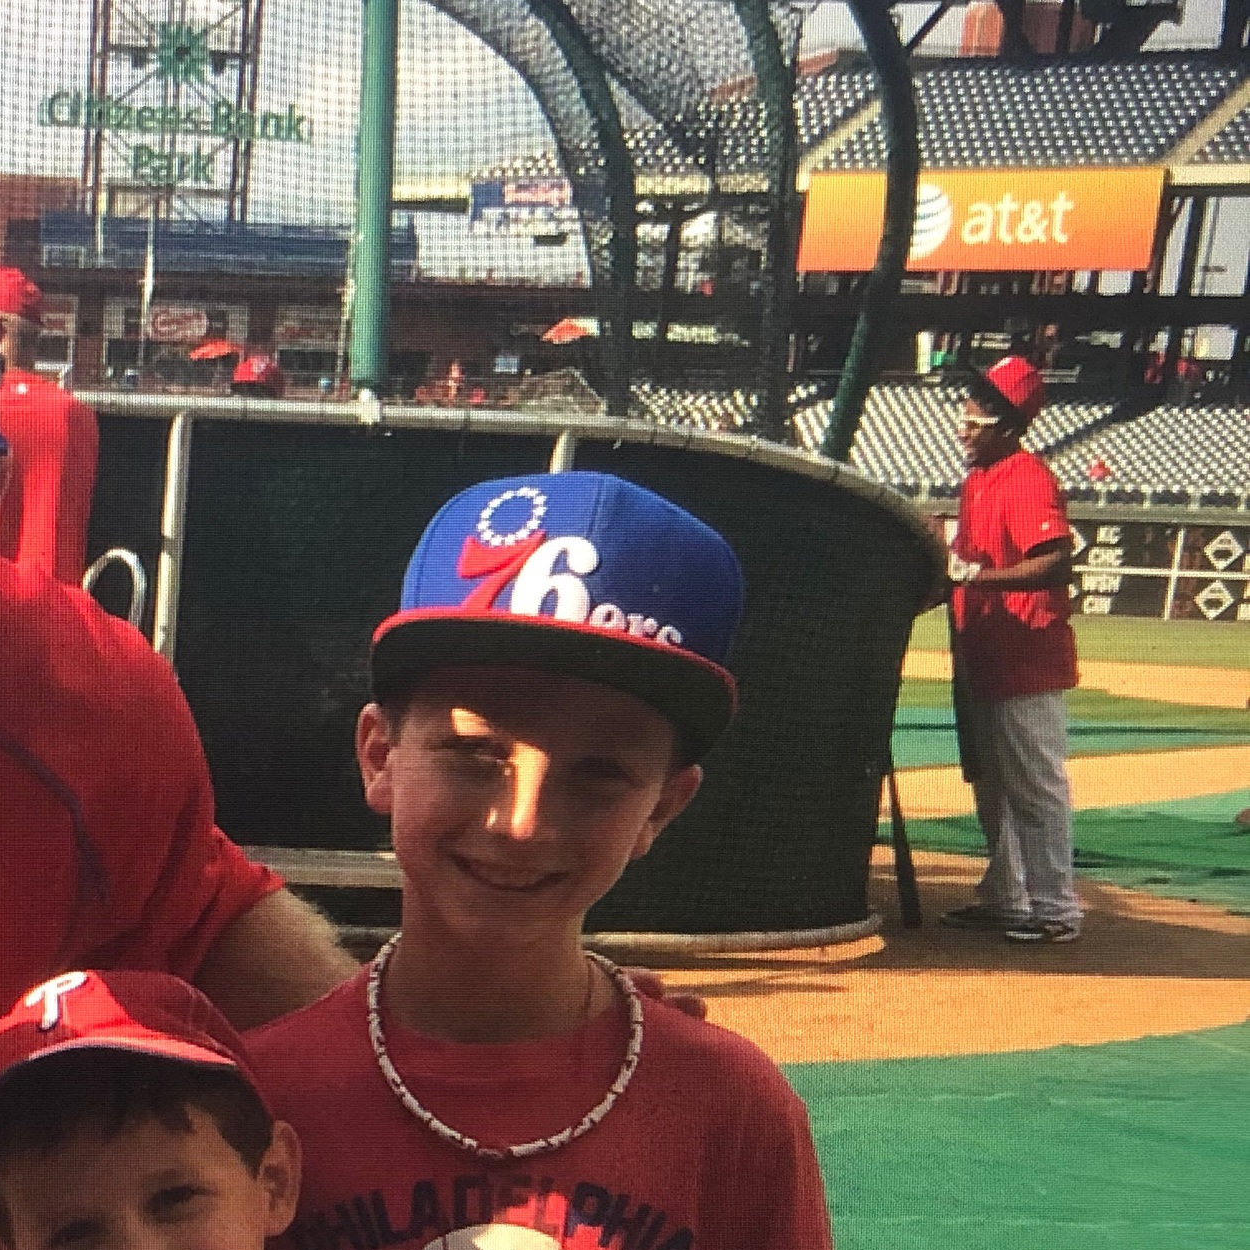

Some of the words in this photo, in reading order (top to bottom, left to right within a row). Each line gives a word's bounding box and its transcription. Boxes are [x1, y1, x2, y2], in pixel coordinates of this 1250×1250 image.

[43, 89, 199, 133] Citizens
[211, 101, 310, 143] Bank
[131, 143, 213, 184] Park
[960, 190, 1075, 245] at&t
